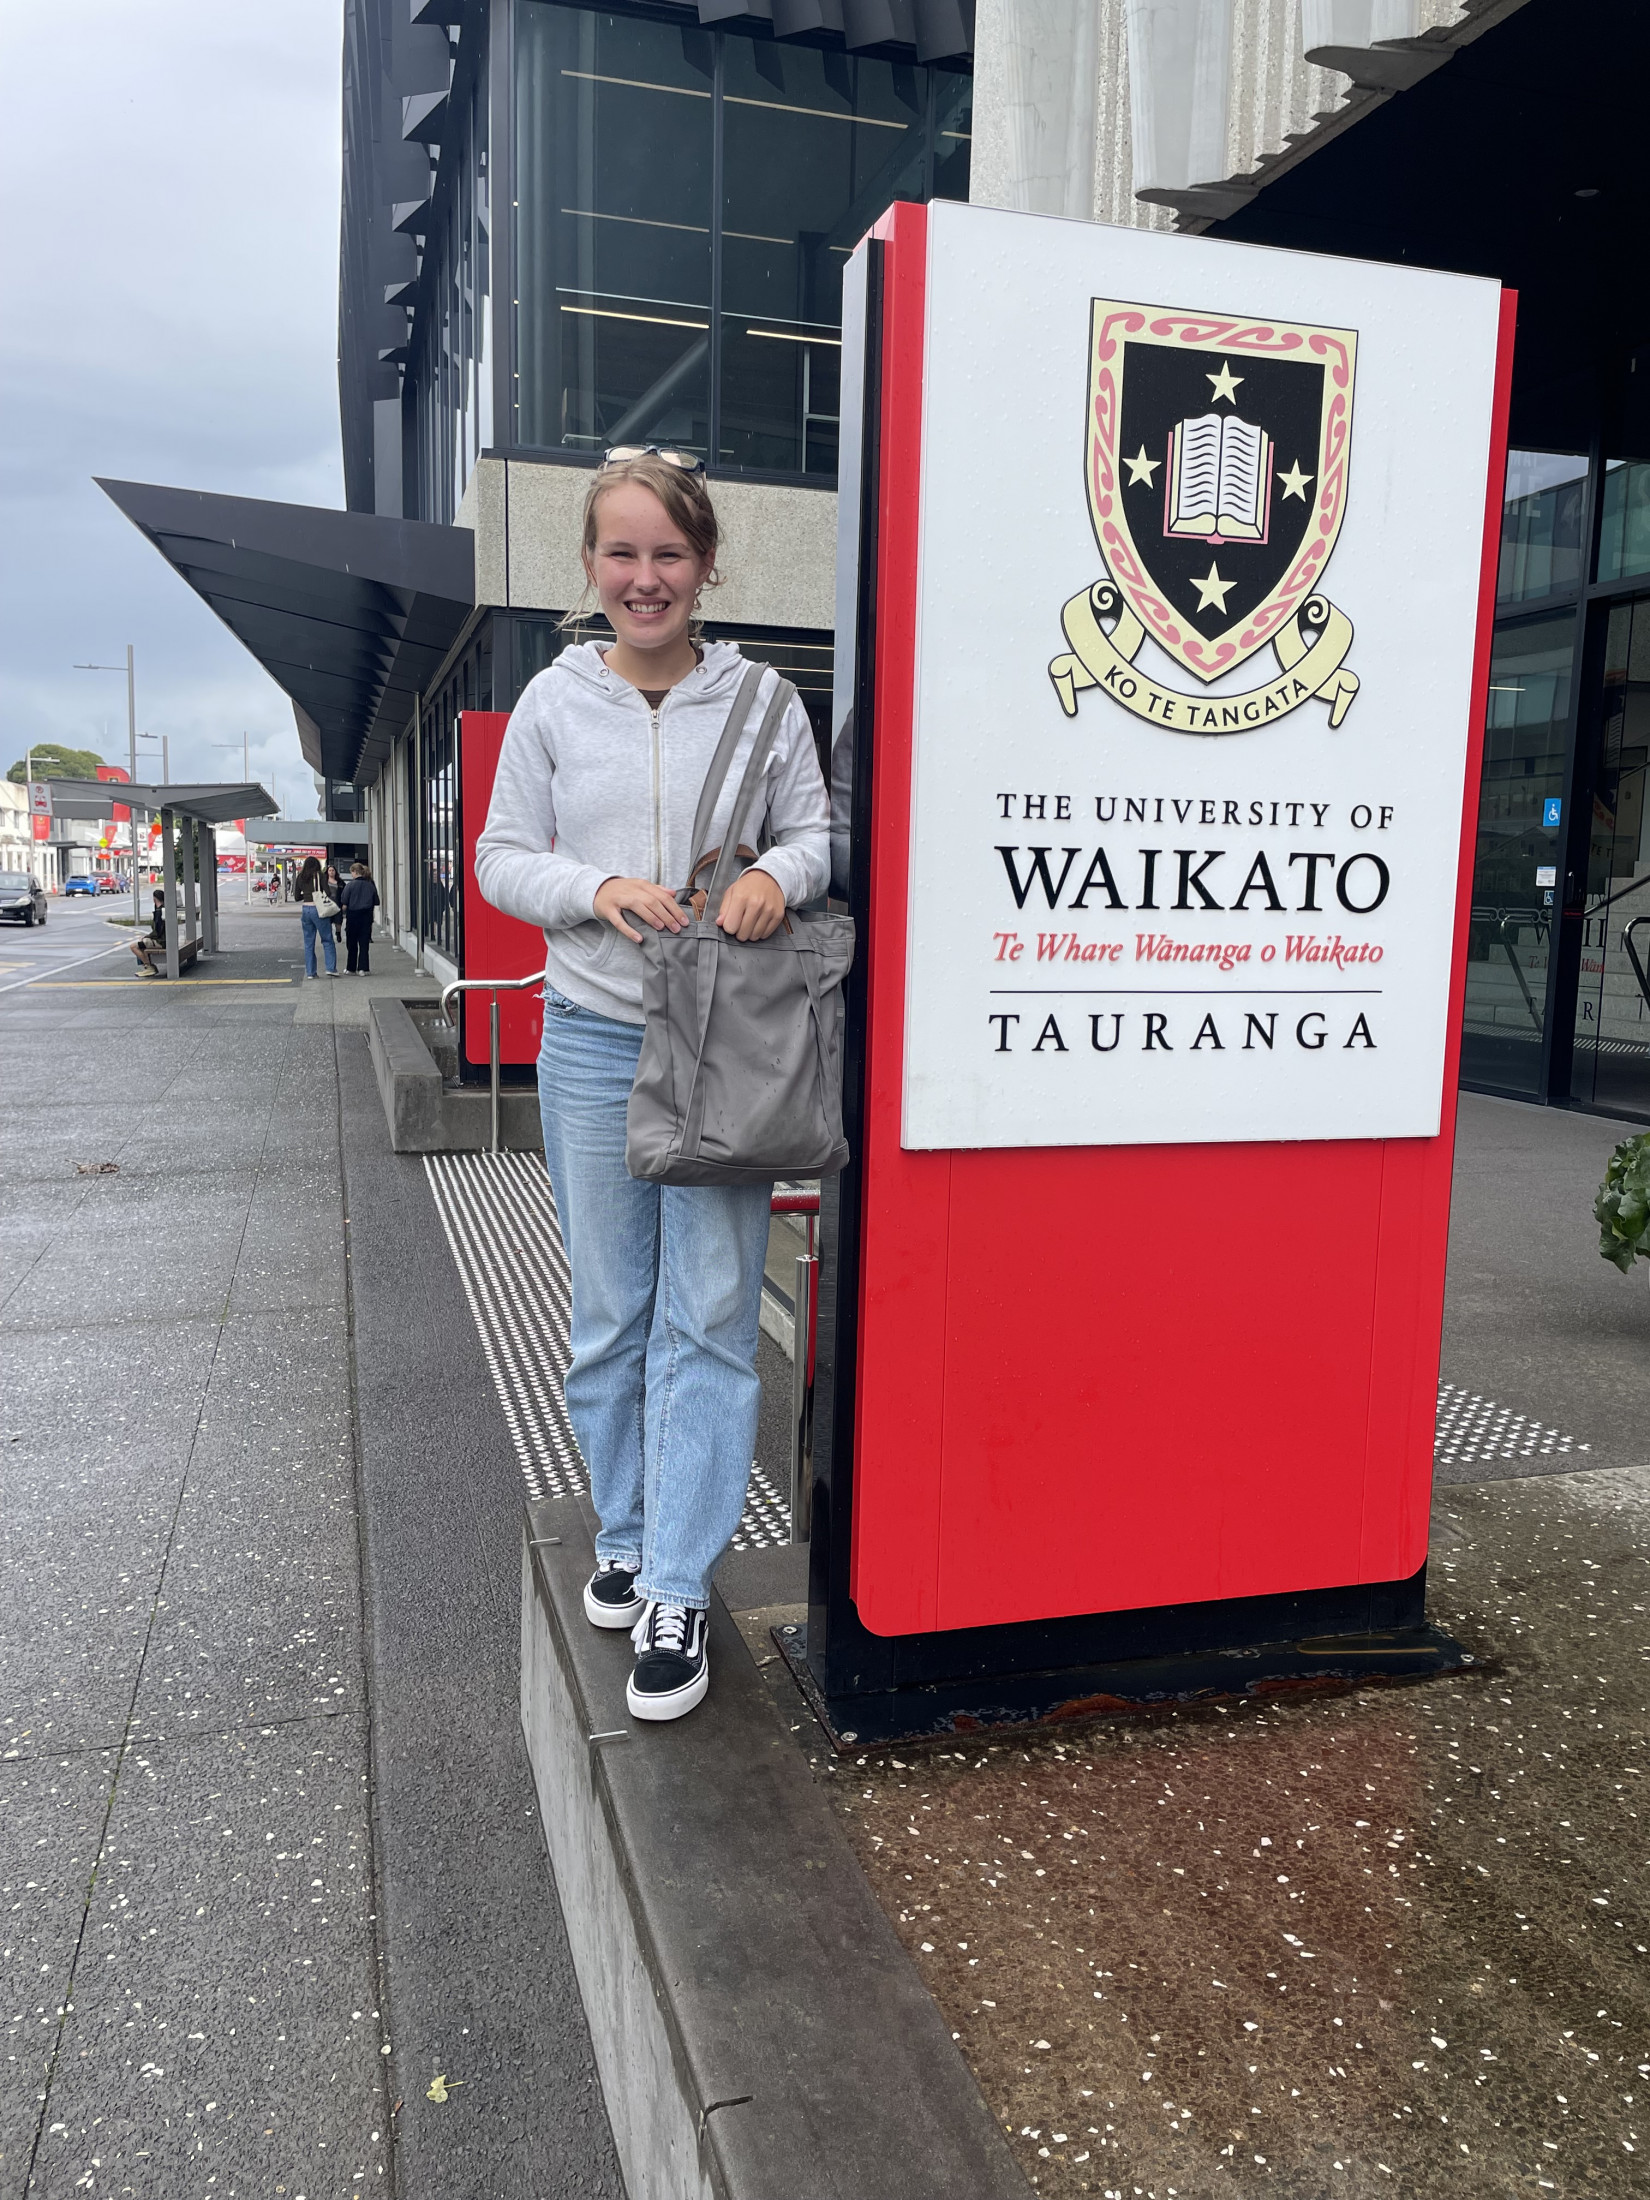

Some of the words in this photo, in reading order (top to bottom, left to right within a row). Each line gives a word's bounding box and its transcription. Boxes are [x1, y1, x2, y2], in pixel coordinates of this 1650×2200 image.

[1104, 664, 1138, 699] KO
[1147, 692, 1176, 721] TE
[1187, 678, 1310, 728] TANGATA
[997, 793, 1071, 820] THE
[1095, 797, 1330, 827] UNIVERSITY
[1351, 805, 1394, 829] OF
[994, 845, 1390, 914] WAIKATO
[993, 932, 1024, 962] Te
[1036, 932, 1124, 963] Whare
[1135, 933, 1252, 970] Wānanga
[1260, 944, 1276, 962] o
[1285, 935, 1384, 970] Waikato
[989, 1012, 1378, 1051] TAURANGA
